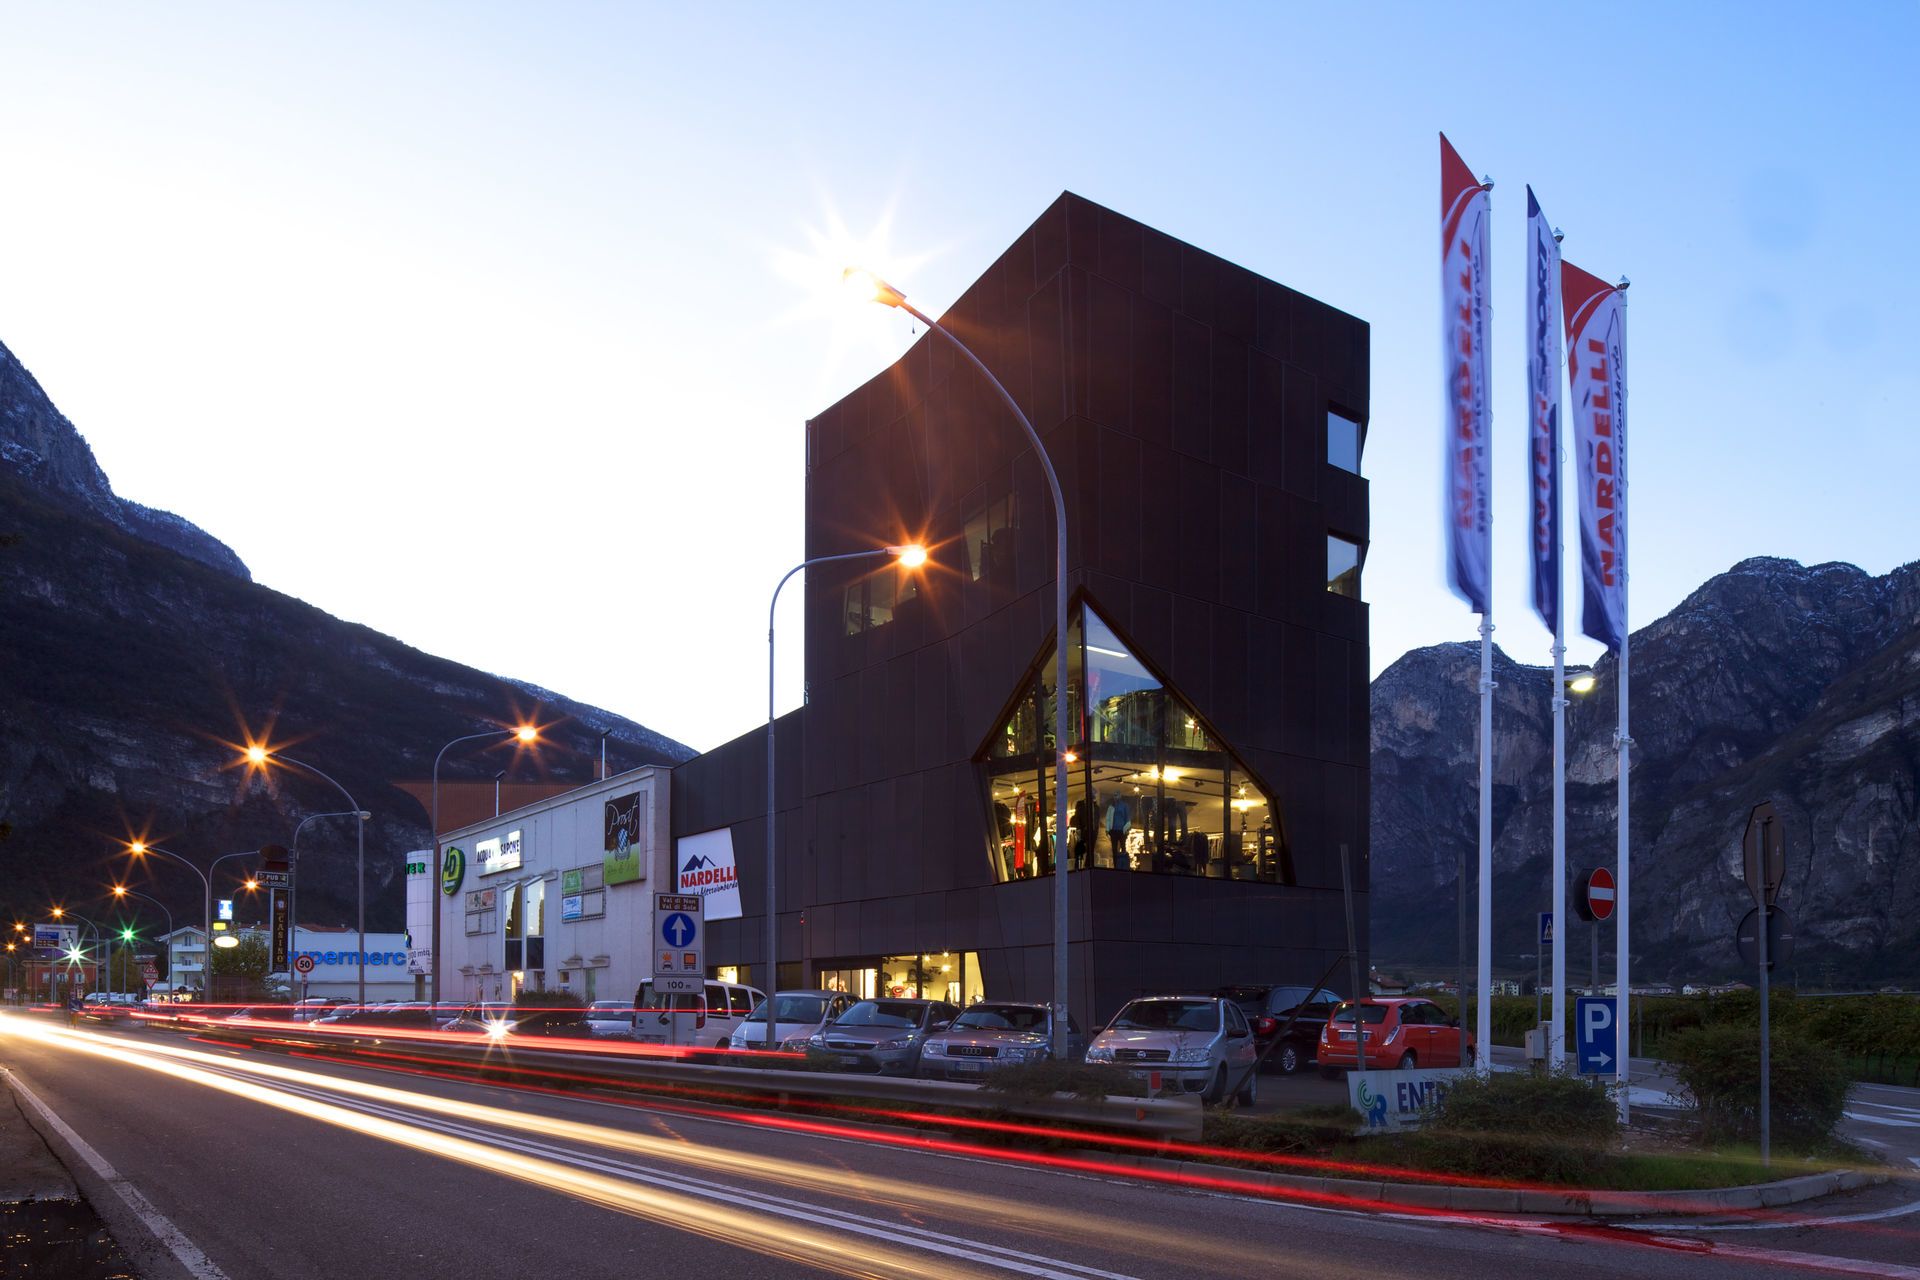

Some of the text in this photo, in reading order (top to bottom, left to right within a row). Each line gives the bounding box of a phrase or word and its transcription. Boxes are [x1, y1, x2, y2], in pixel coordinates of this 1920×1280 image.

[1588, 338, 1615, 588] NARDELLI
[500, 839, 519, 856] SAPONE
[681, 865, 737, 889] NARDELLI
[299, 960, 310, 968] 50
[667, 981, 684, 989] 100
[1584, 1003, 1612, 1043] P
